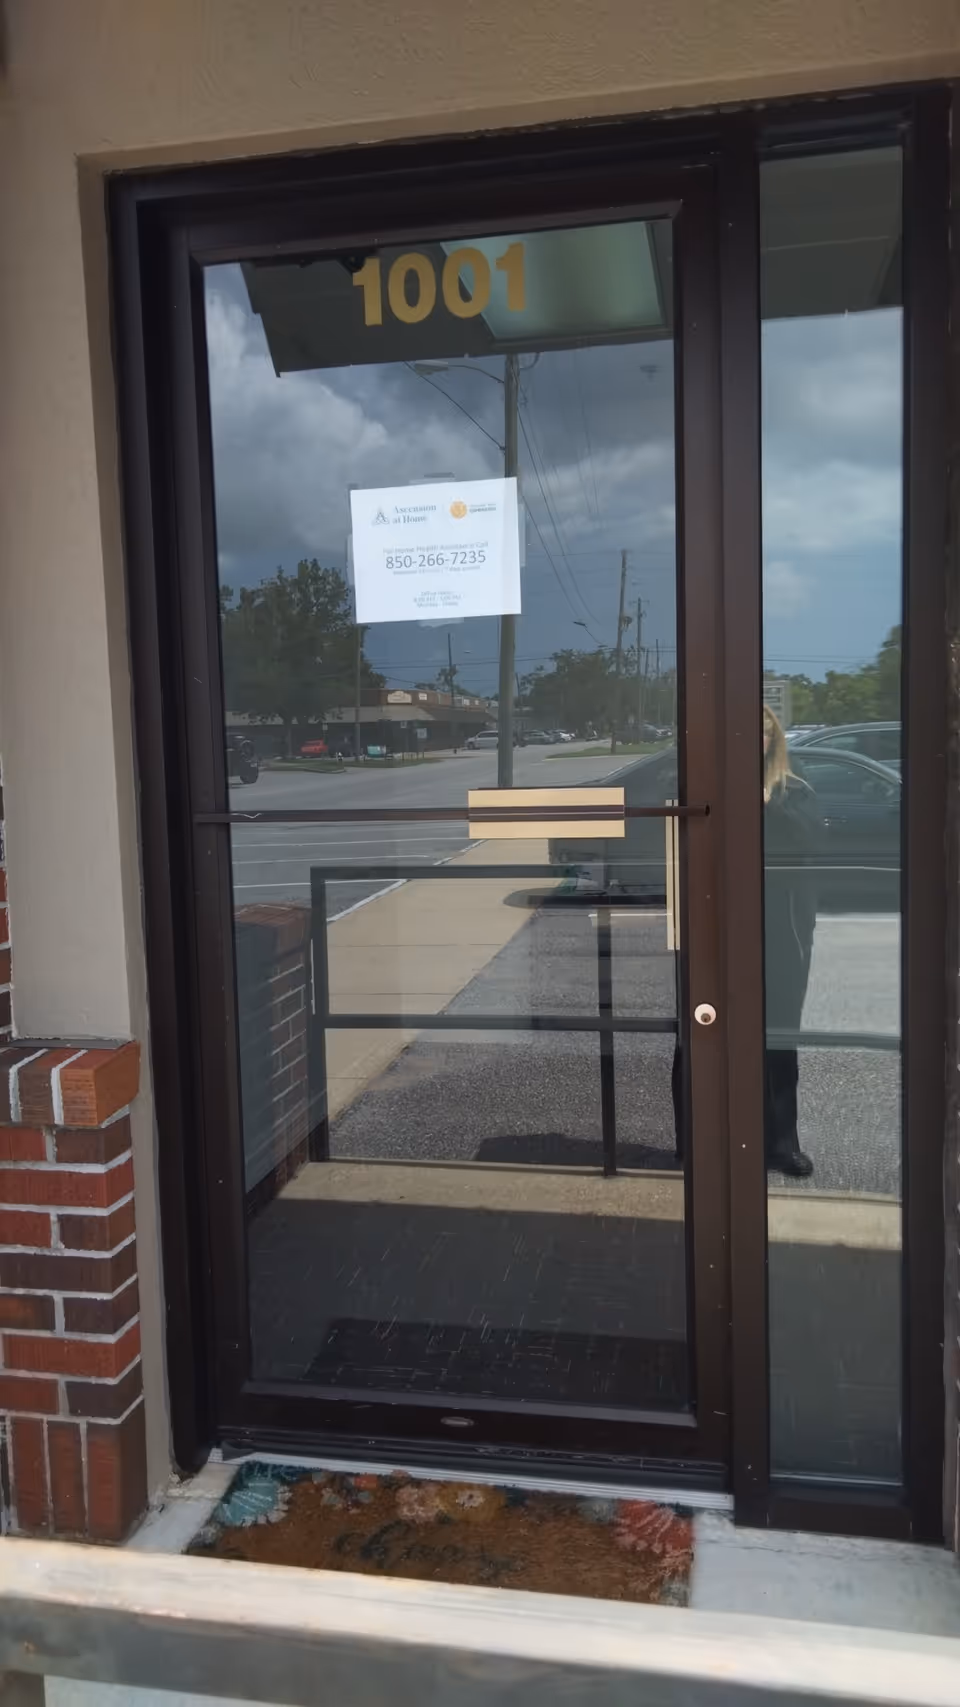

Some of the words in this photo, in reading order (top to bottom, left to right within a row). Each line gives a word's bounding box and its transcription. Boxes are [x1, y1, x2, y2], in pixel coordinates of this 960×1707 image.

[352, 242, 527, 327] 1001
[393, 505, 437, 513] Ascension
[403, 514, 428, 523] Home
[385, 550, 486, 569] 850-266-7235
